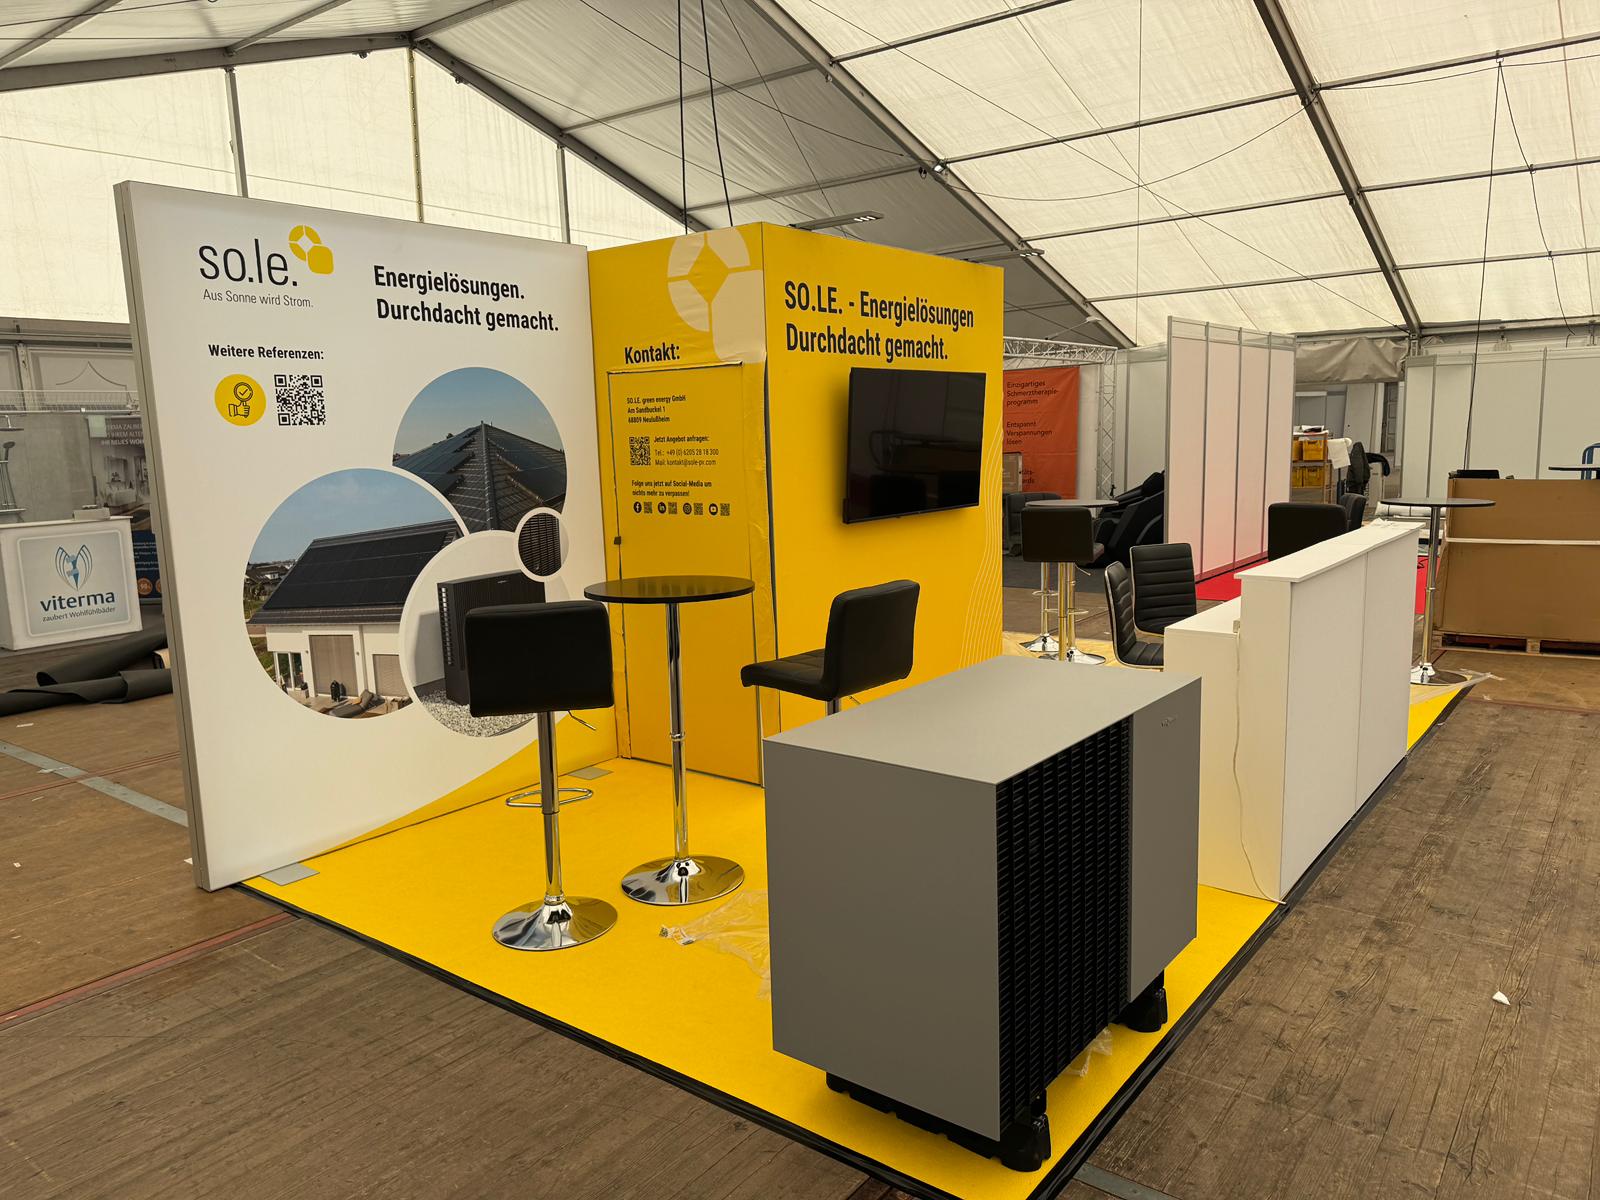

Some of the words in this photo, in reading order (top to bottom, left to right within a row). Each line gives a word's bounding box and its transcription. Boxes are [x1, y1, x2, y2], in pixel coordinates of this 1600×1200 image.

[199, 239, 298, 286] so.le.
[373, 265, 525, 301] Energielösungen.
[203, 289, 223, 302] Aus
[225, 290, 256, 304] Sonne
[259, 293, 281, 306] wird
[283, 295, 314, 308] Strom.
[785, 280, 843, 314] SO.LE.
[860, 291, 974, 332] Energielösungen
[376, 298, 482, 326] Durchdacht
[485, 309, 559, 332] gemacht.
[786, 323, 881, 356] Durchdacht
[885, 334, 948, 363] gemacht.
[208, 344, 255, 358] Weitere
[258, 346, 324, 360] Referenzen:
[624, 342, 680, 364] Kontakt:
[1007, 381, 1046, 389] Einzigartiges
[1007, 388, 1058, 397] Schmerztherapie-
[655, 396, 671, 404] energy
[1007, 399, 1038, 407] programm
[642, 415, 671, 423] Neulußheim
[1007, 421, 1037, 429] Entspannt
[1007, 430, 1052, 438] Verspannungen
[40, 590, 115, 612] viterma
[42, 612, 69, 622] zaubert
[69, 606, 117, 619] Wohlfühlbäder
